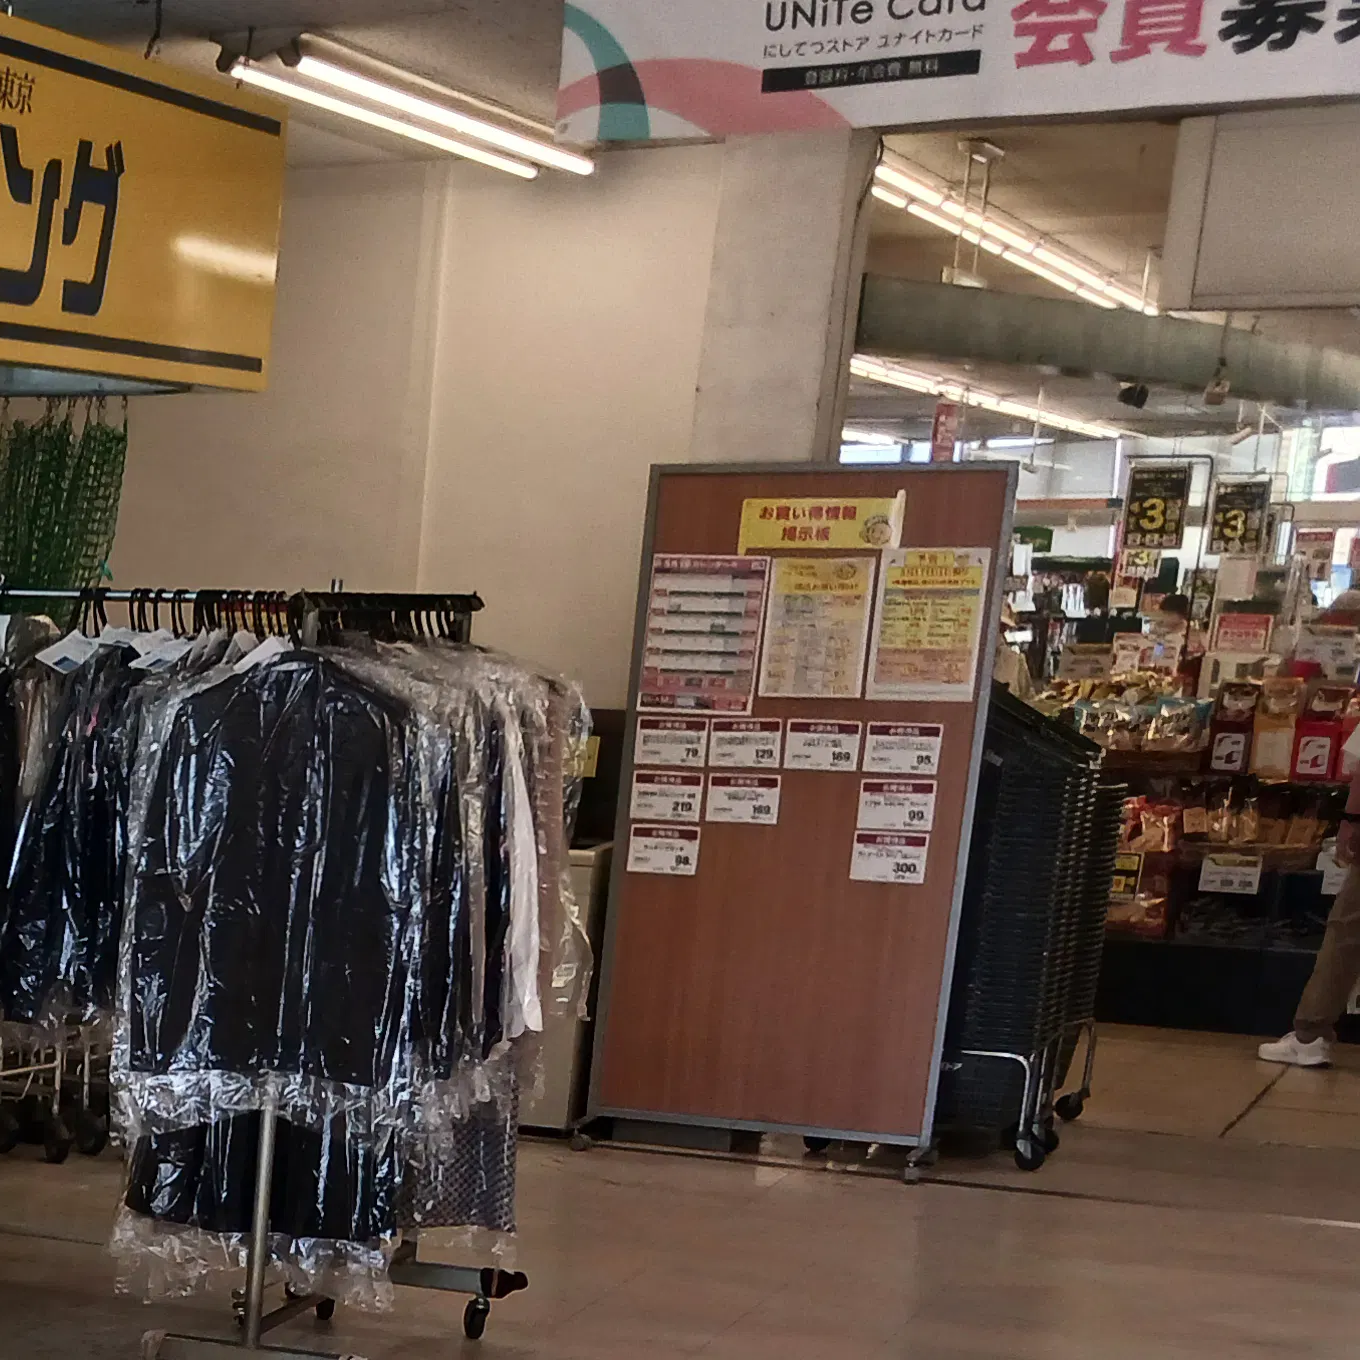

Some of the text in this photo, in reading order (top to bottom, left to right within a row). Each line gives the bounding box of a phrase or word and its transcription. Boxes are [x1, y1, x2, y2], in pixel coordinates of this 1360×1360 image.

[887, 0, 986, 20] Car
[763, 24, 984, 58] にしてつストア ユナイトカード
[781, 525, 831, 542] 掲示板
